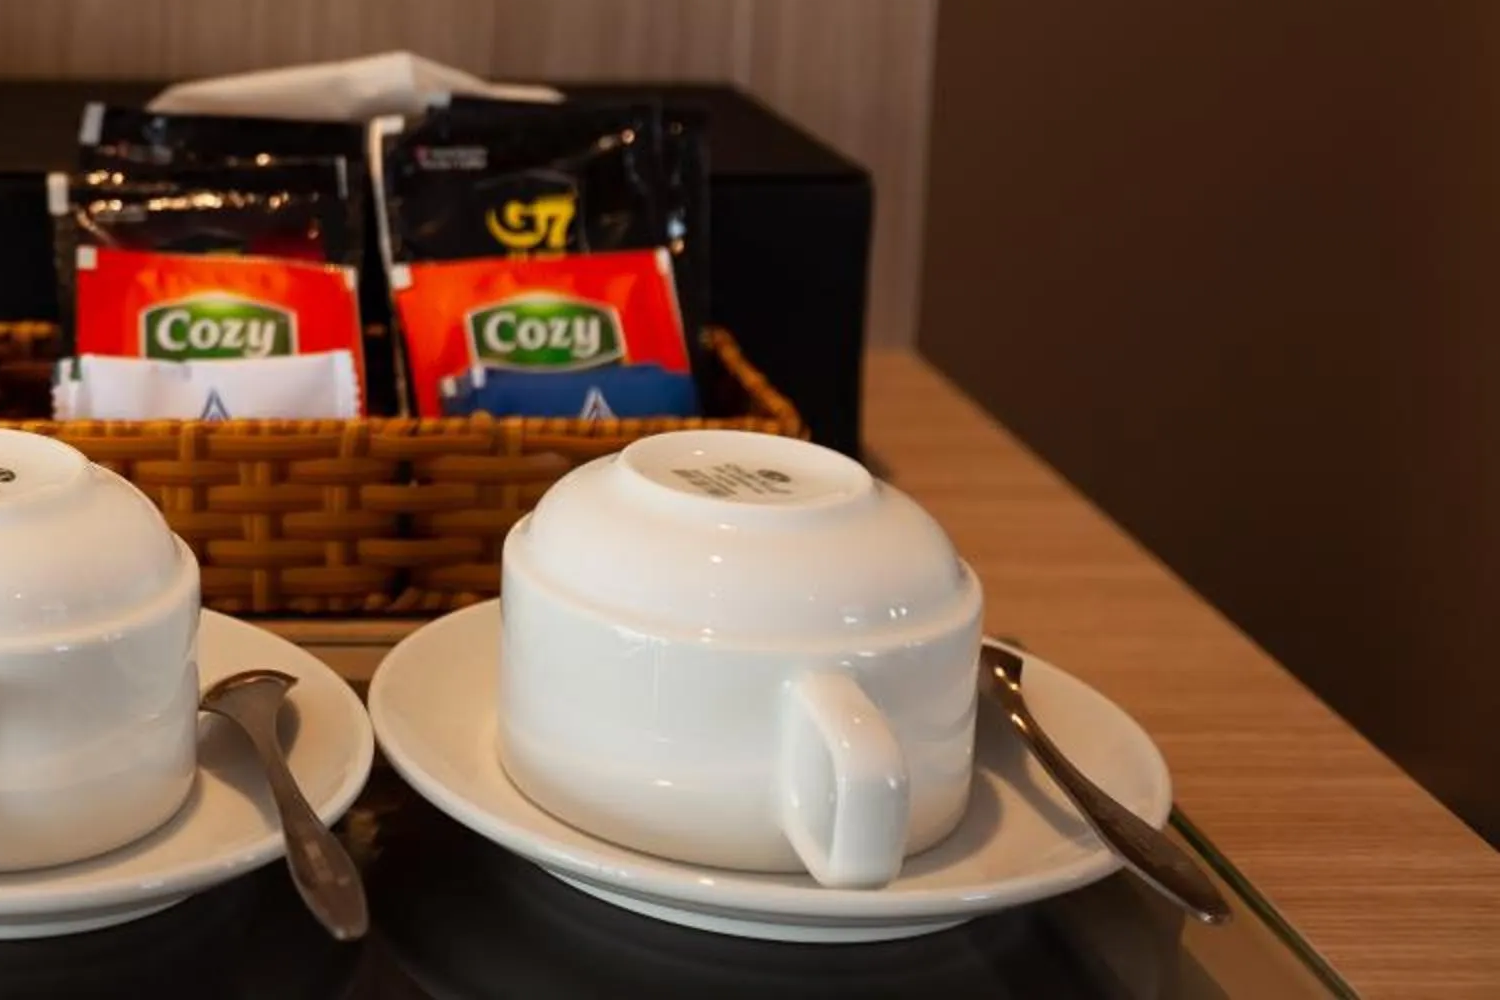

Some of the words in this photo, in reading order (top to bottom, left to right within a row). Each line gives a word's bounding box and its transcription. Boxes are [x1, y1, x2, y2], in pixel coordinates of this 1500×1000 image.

[485, 194, 576, 250] G7
[156, 309, 276, 358] Cozy
[483, 310, 601, 358] Cozy
